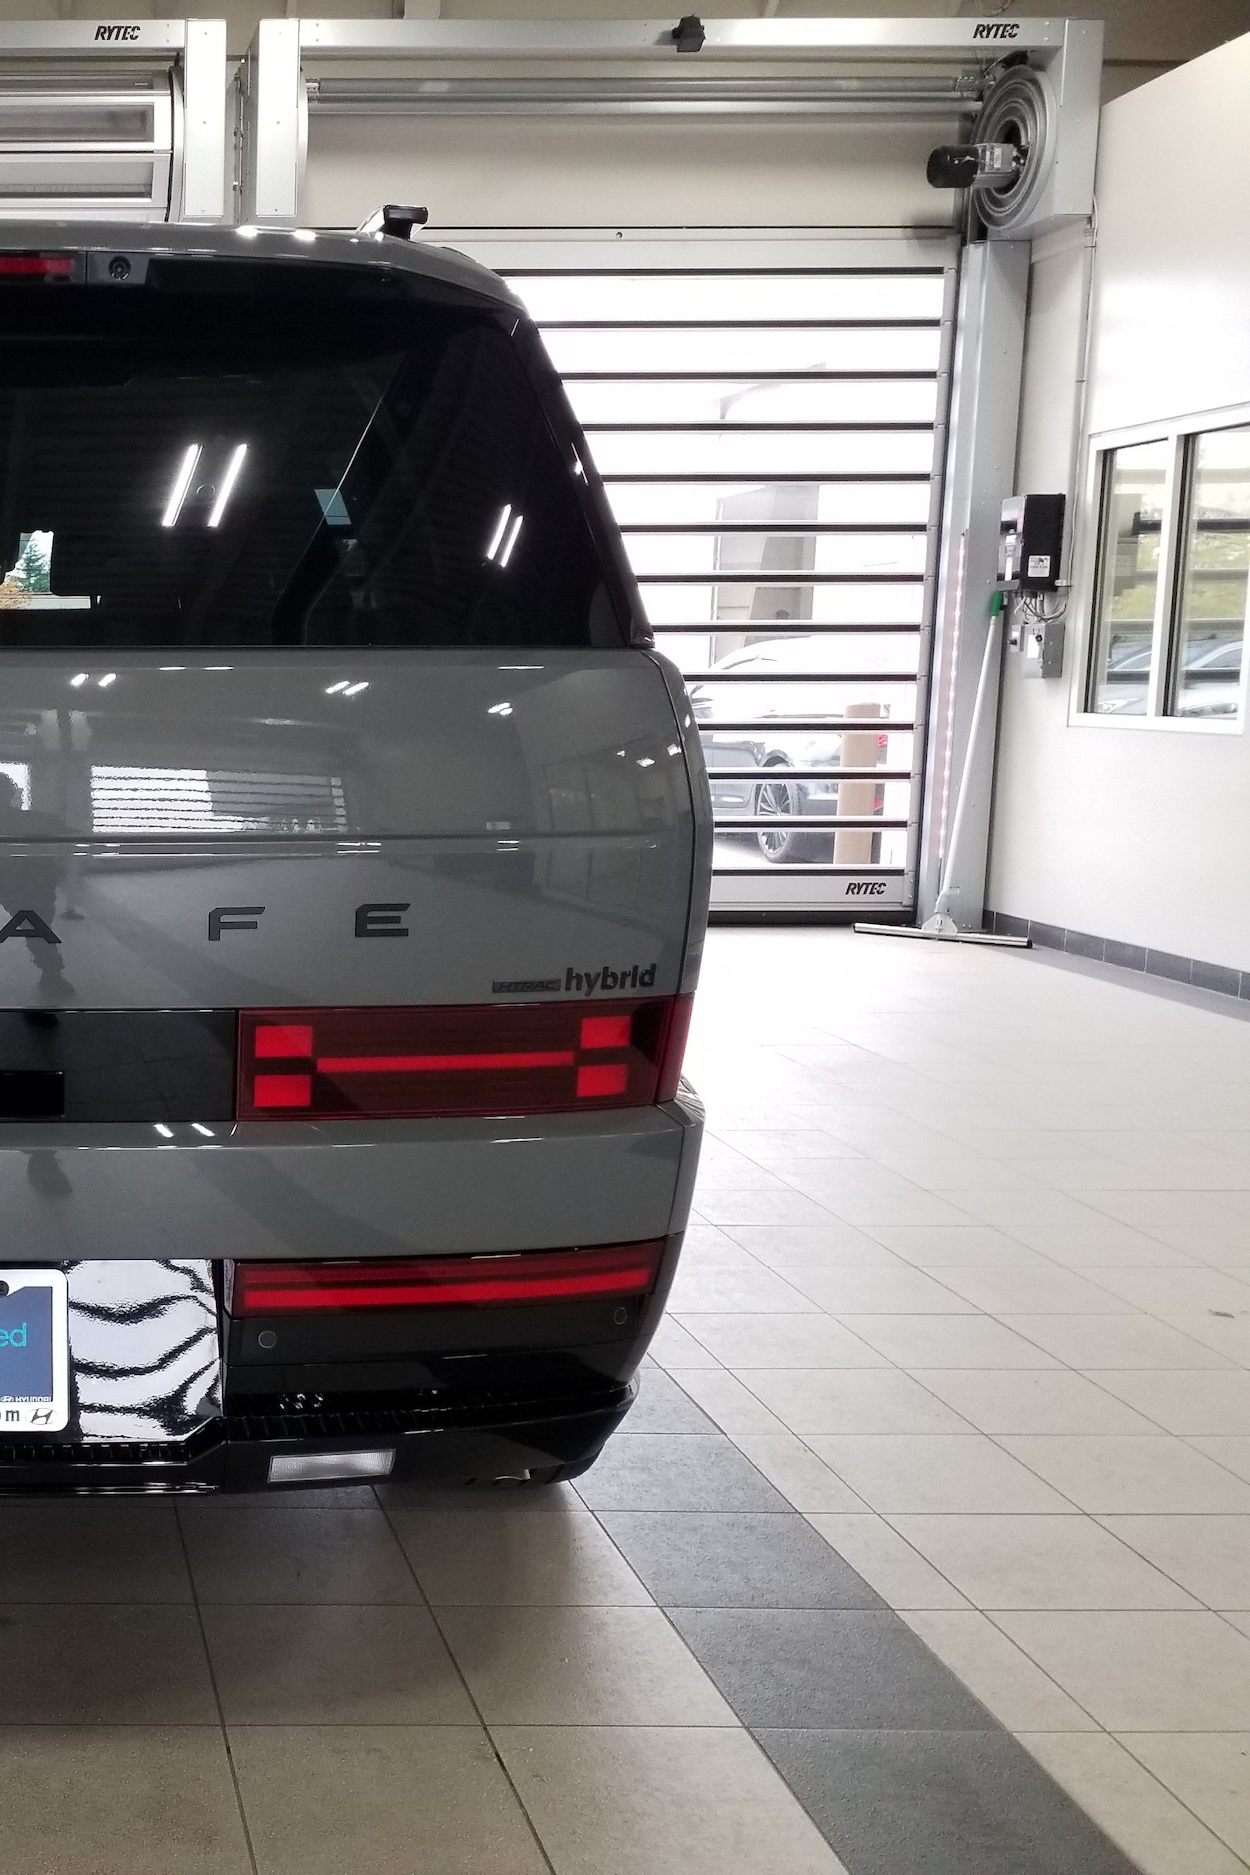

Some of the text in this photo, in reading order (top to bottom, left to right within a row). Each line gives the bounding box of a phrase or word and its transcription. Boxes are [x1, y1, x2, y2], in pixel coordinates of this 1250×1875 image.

[94, 25, 141, 41] RYTEC
[972, 23, 1020, 39] RYTEC
[845, 882, 887, 895] RYTEC
[208, 902, 411, 942] FE
[565, 963, 657, 996] hybrid
